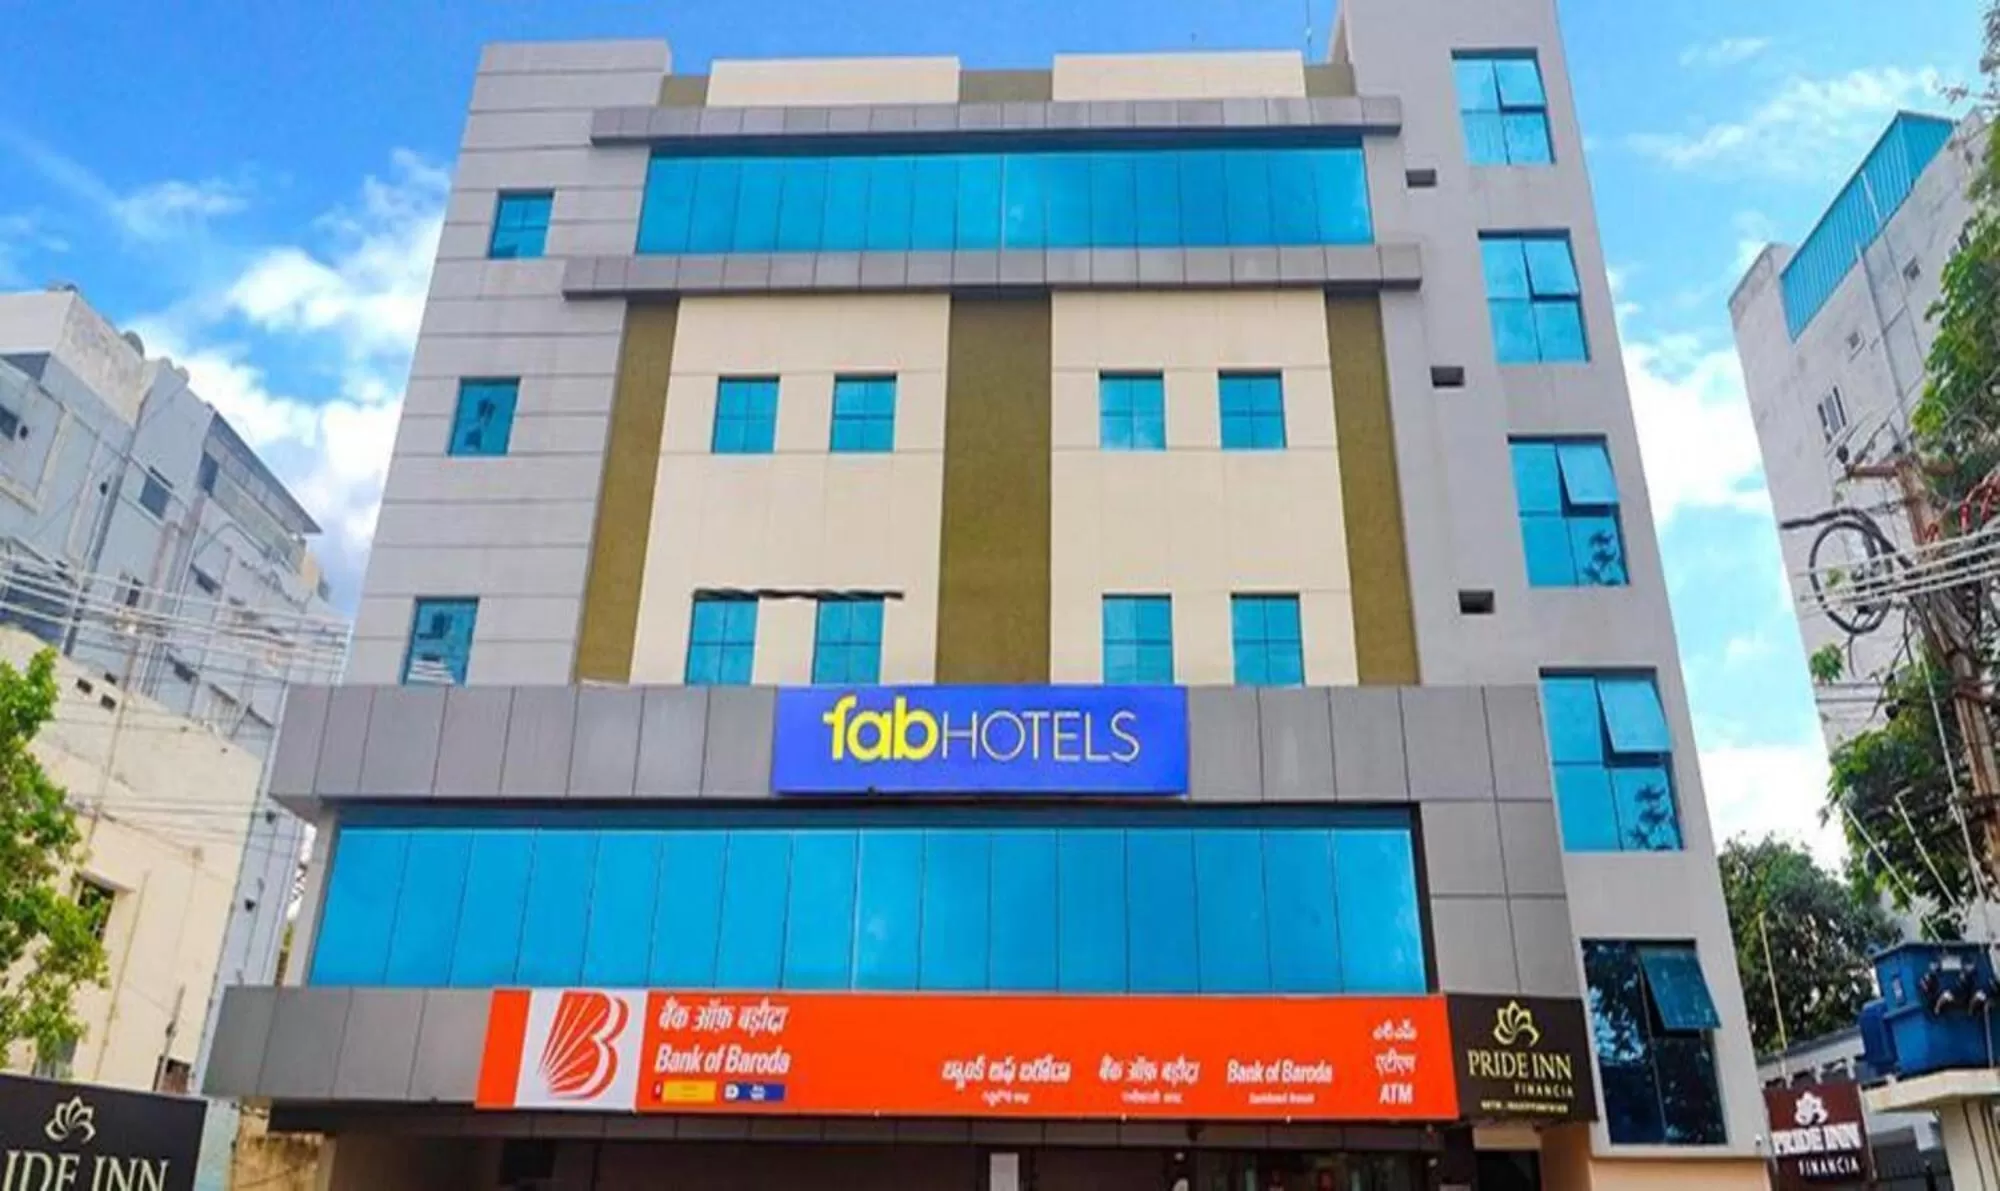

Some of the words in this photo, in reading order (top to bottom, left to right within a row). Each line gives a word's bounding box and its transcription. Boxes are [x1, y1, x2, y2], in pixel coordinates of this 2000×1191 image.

[823, 695, 1141, 762] fabHOTELS
[655, 1043, 704, 1073] Bank
[704, 1043, 727, 1073] of
[725, 1043, 791, 1074] Baroda
[1227, 1059, 1264, 1083] Bank
[1265, 1059, 1282, 1083] of
[1282, 1059, 1333, 1084] Baroda
[1467, 1048, 1529, 1079] PRIDE
[1531, 1052, 1573, 1081] INN
[1379, 1083, 1413, 1105] ATM
[1514, 1082, 1575, 1098] FINANCIA
[91, 1155, 170, 1191] INN
[1798, 1156, 1861, 1177] FINANCIA
